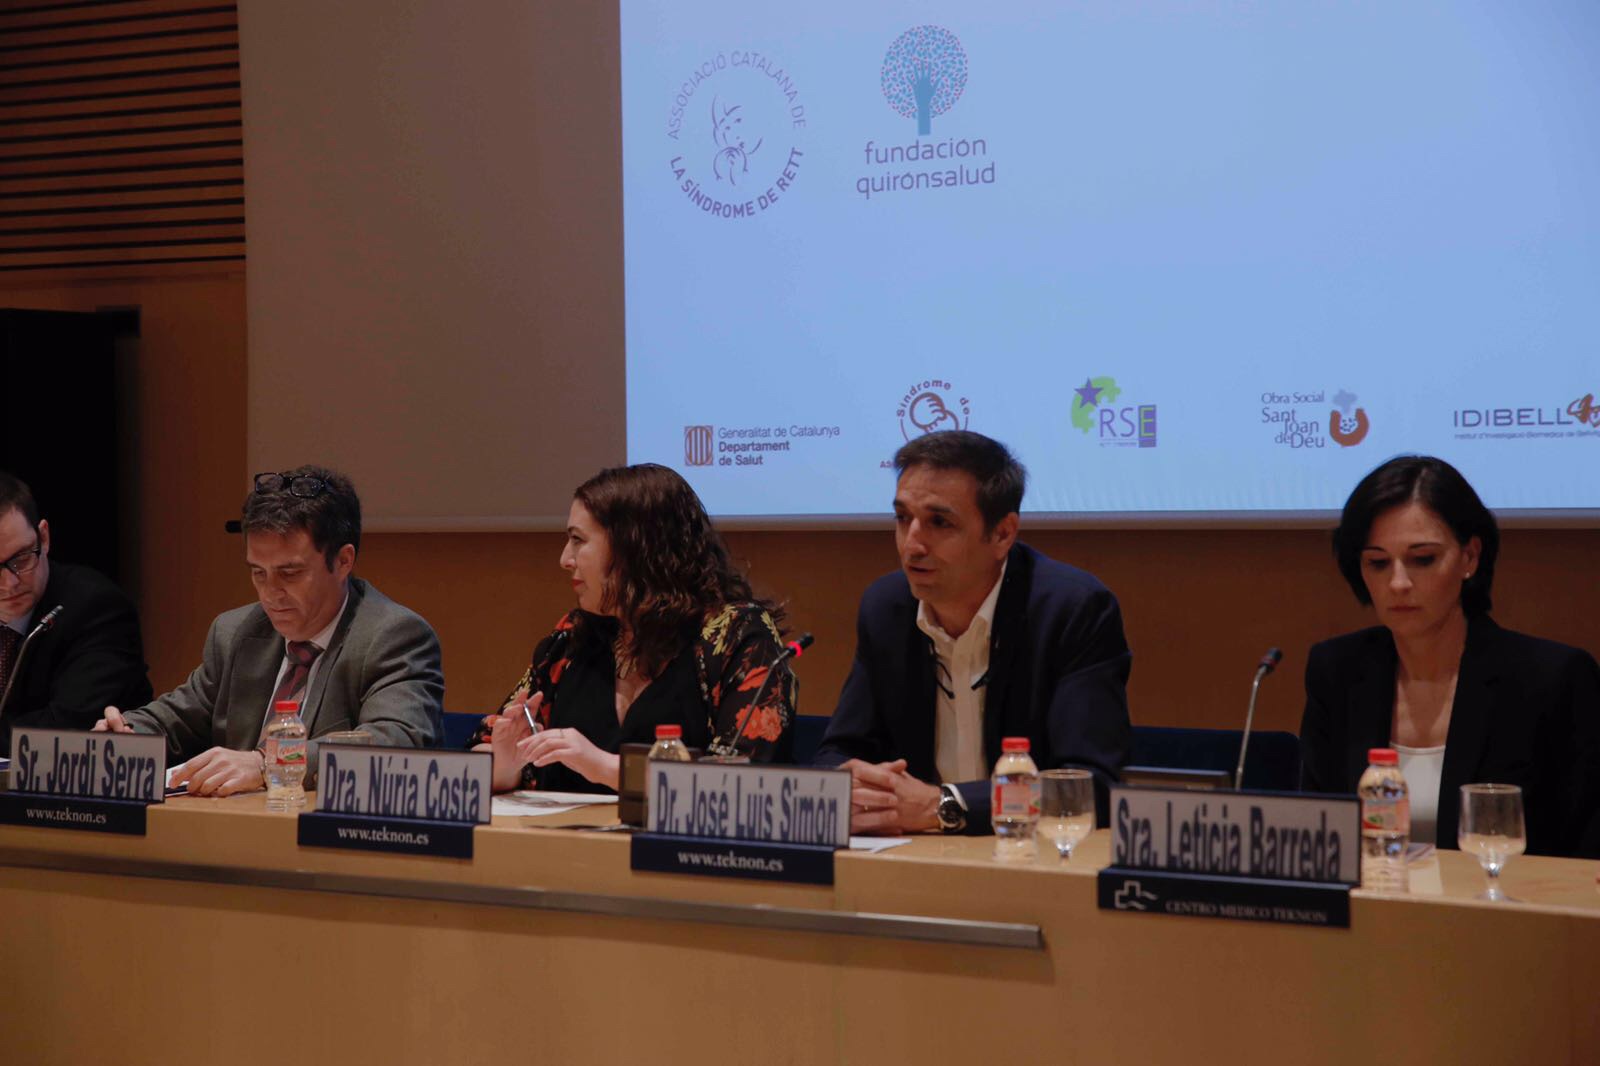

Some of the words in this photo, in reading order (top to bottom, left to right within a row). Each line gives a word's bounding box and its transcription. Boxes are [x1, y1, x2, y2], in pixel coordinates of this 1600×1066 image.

[731, 49, 798, 103] CATALANA
[791, 104, 807, 129] DE
[864, 138, 987, 165] fundación
[670, 156, 687, 181] LA
[681, 178, 756, 219] SÍNDROME
[757, 191, 779, 212] DE
[776, 146, 804, 193] RETT
[856, 162, 996, 201] quirónsalud
[1261, 391, 1290, 404] Obra
[1293, 390, 1325, 404] Social
[1099, 404, 1157, 438] RSE
[1262, 406, 1296, 423] Sant
[1454, 407, 1573, 427] IDIBELL
[718, 426, 771, 439] Generalitat
[774, 426, 787, 438] de
[789, 425, 840, 439] Catalunya
[718, 440, 790, 453] Departament
[718, 455, 732, 466] de
[735, 454, 764, 466] Salut
[16, 734, 40, 791] Sr.
[47, 736, 97, 795] Jordi
[101, 739, 156, 800] Serra
[324, 751, 359, 813] Dra.
[368, 754, 419, 821] Núria
[425, 759, 481, 822] Costa
[26, 808, 107, 824] www.teknon.es
[656, 770, 680, 833] Dr.
[685, 771, 728, 836] José
[736, 775, 773, 840] Luis
[779, 776, 838, 844] Simón
[337, 825, 430, 845] www.teknon.es
[1116, 797, 1158, 869] Sra.
[1166, 799, 1241, 875] Leticia
[1250, 805, 1341, 881] Barreda
[677, 850, 784, 872] www.teknon.es
[1165, 900, 1218, 914] CENTRO
